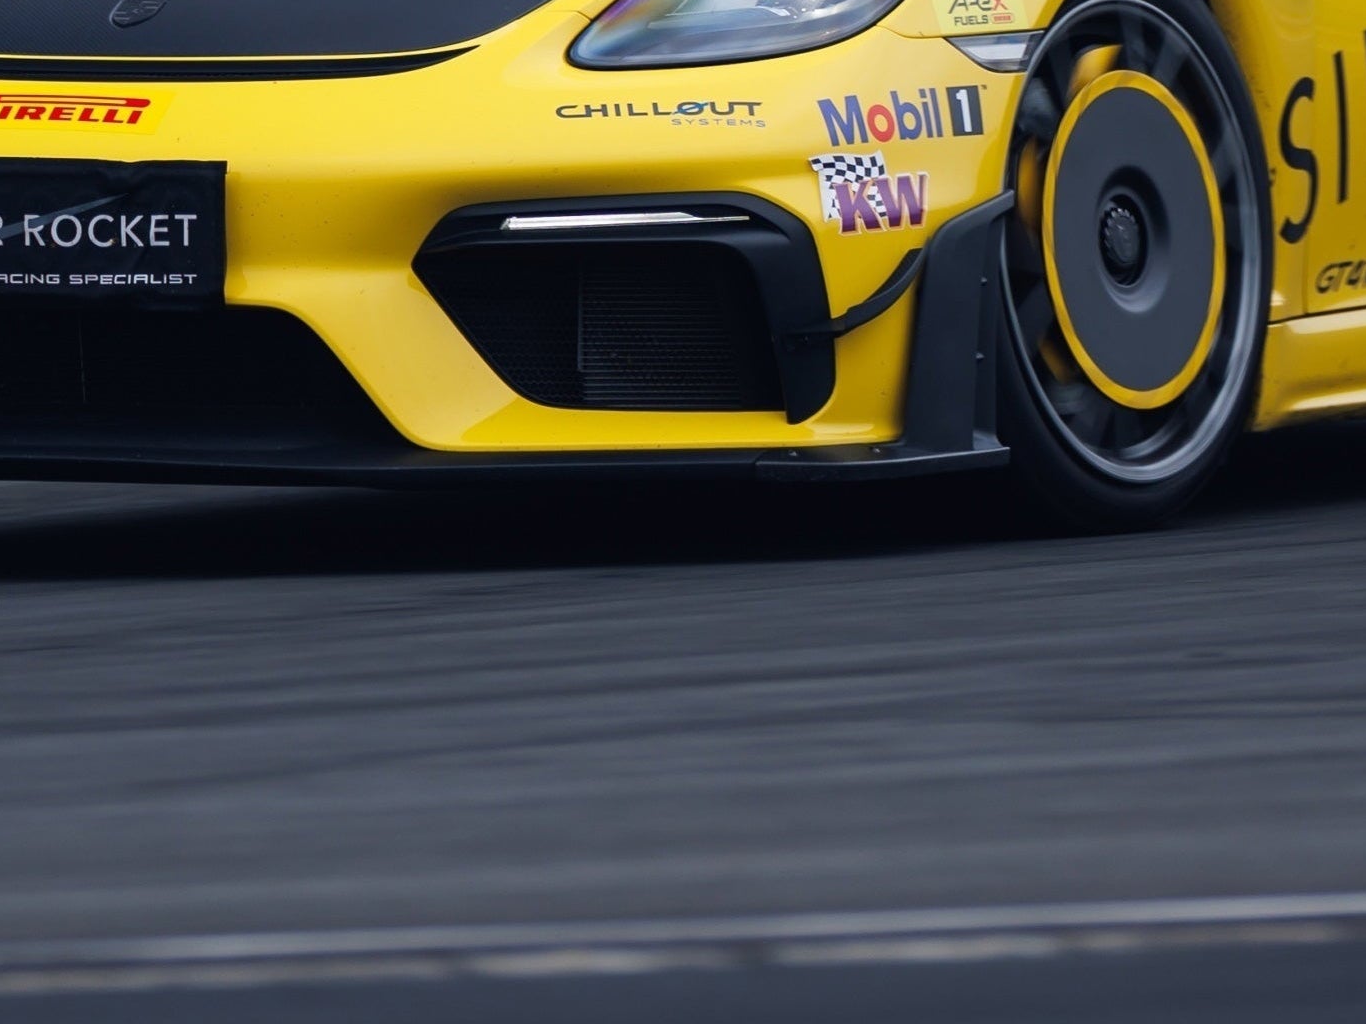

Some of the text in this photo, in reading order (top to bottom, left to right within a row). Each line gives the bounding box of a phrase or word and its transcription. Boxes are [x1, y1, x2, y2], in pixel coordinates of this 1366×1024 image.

[953, 13, 989, 27] FUELS
[670, 118, 767, 128] SYSTEMS
[817, 87, 944, 147] Mobil
[832, 174, 929, 234] KW
[23, 214, 198, 248] ROCKET
[68, 273, 198, 286] SPECIALIST
